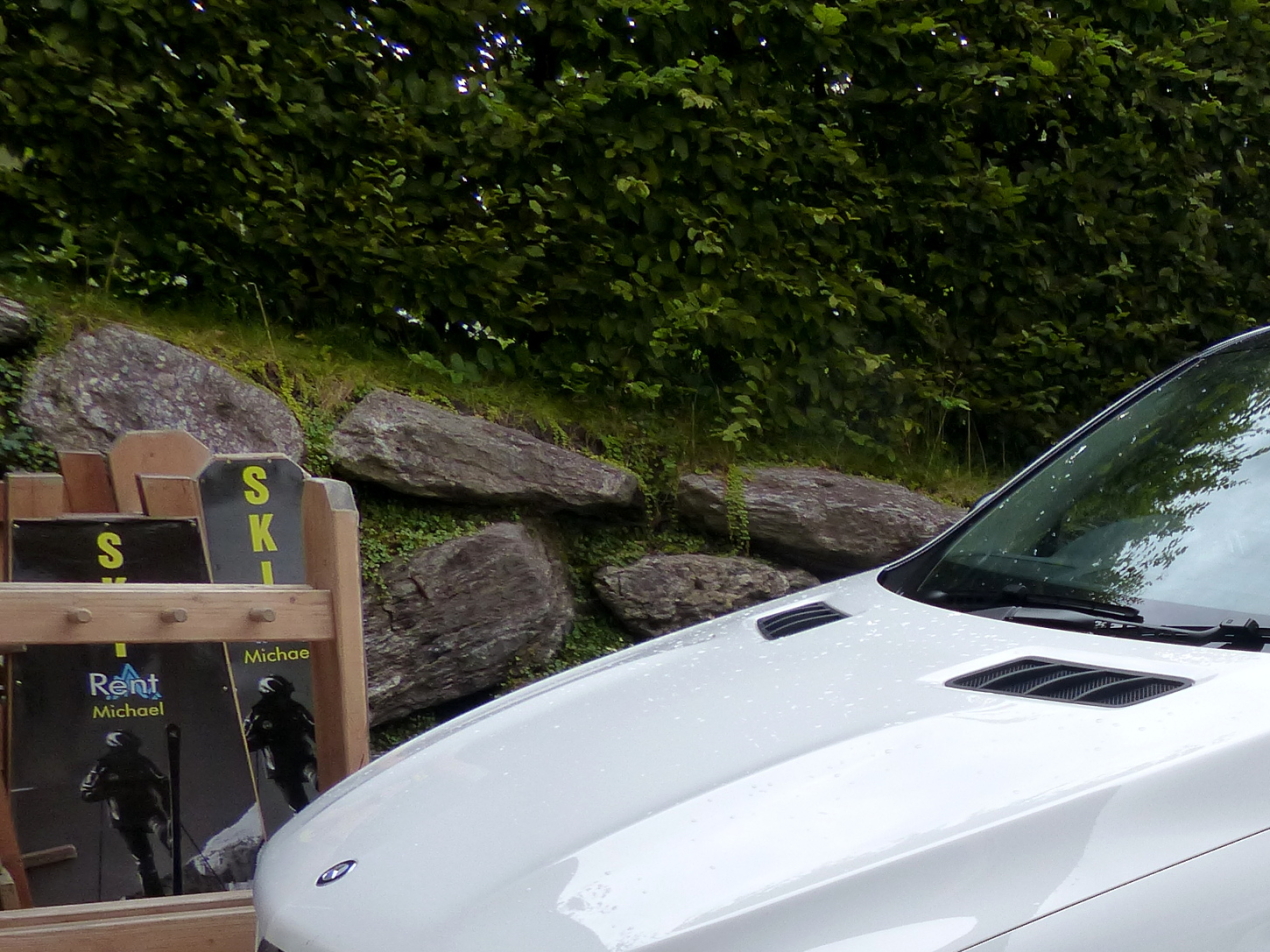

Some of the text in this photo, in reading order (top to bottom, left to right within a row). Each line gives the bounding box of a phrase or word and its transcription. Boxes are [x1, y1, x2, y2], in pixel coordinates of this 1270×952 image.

[244, 646, 311, 664] Michae
[88, 672, 160, 697] Rent
[92, 701, 164, 719] Michael
